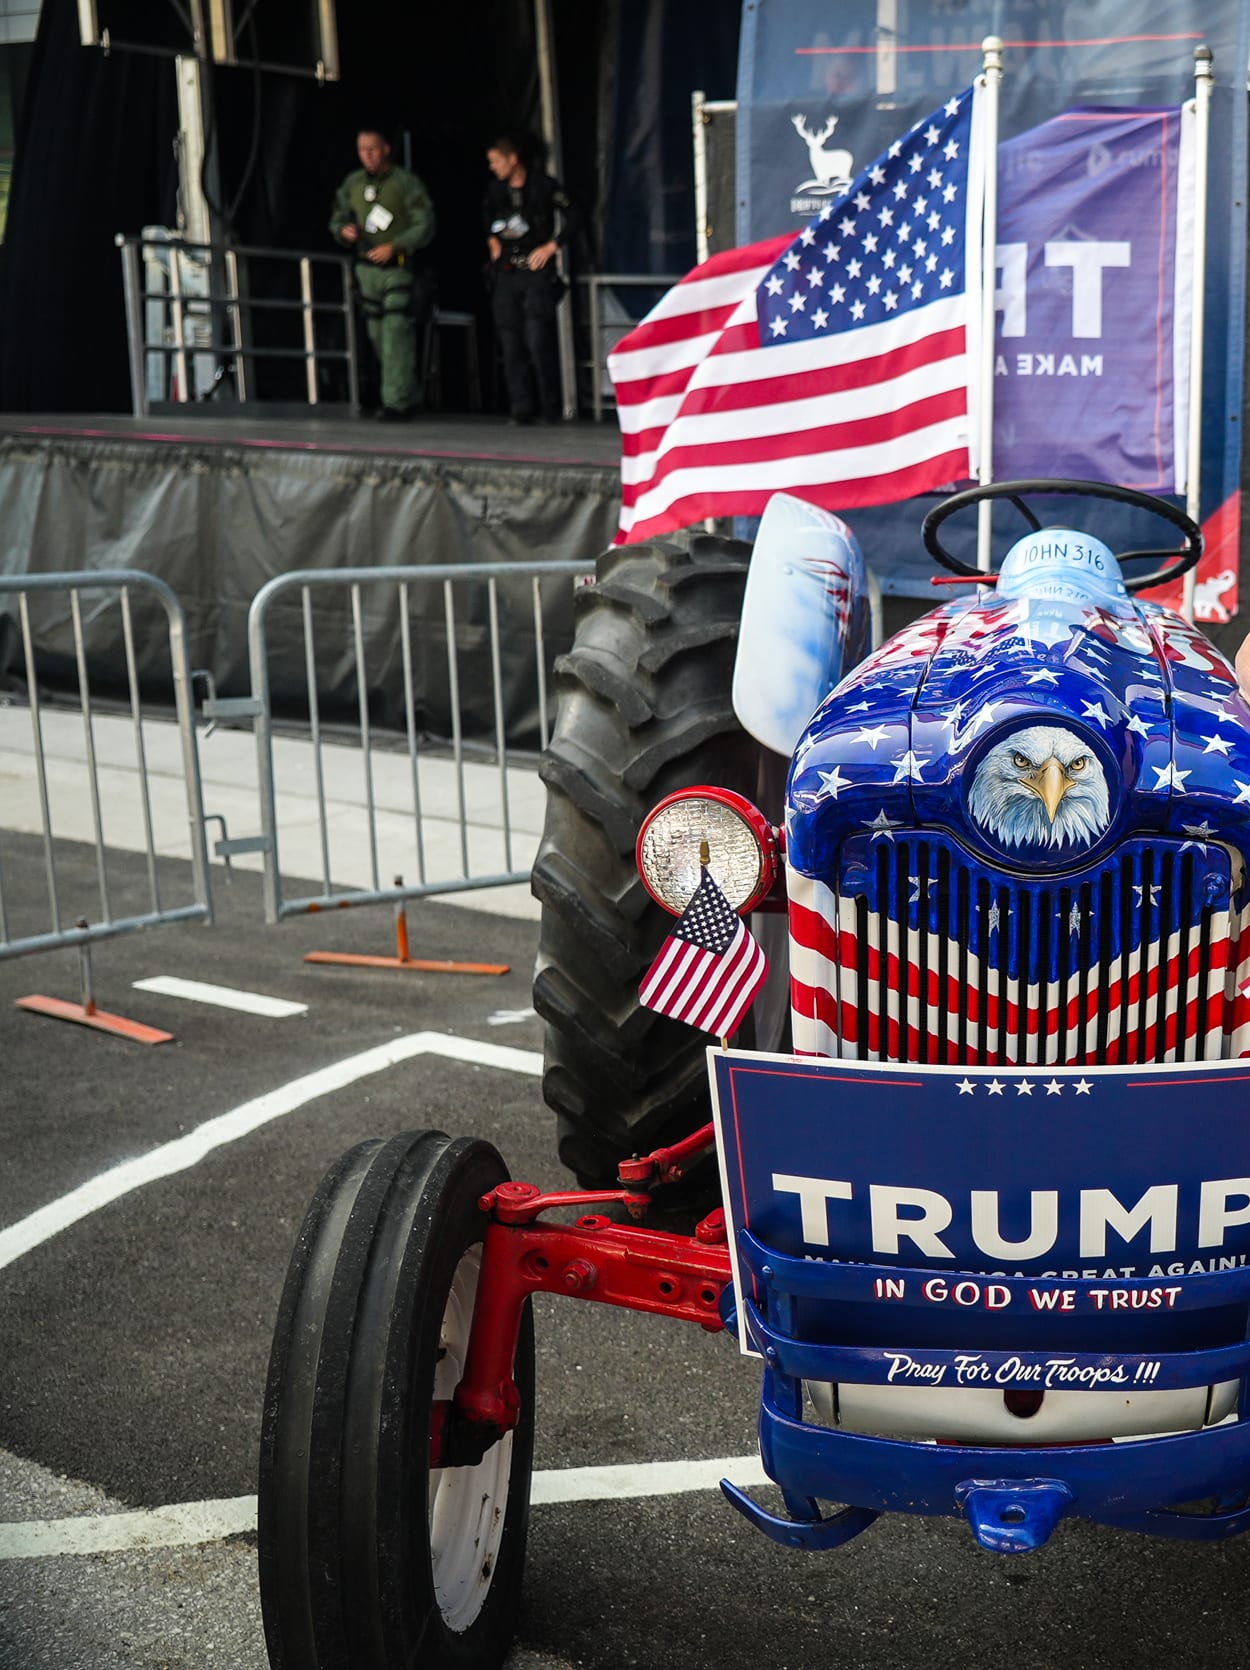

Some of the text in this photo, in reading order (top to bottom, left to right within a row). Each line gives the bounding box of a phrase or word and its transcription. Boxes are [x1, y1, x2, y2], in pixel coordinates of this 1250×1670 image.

[1024, 544, 1067, 565] JOHN
[1147, 1254, 1246, 1278] AGAIN!
[873, 1278, 1182, 1312] IN GOD WE TRUST
[884, 1352, 946, 1386] Pray
[954, 1354, 991, 1385] For
[995, 1356, 1041, 1384] Our
[1045, 1357, 1128, 1388] Troops
